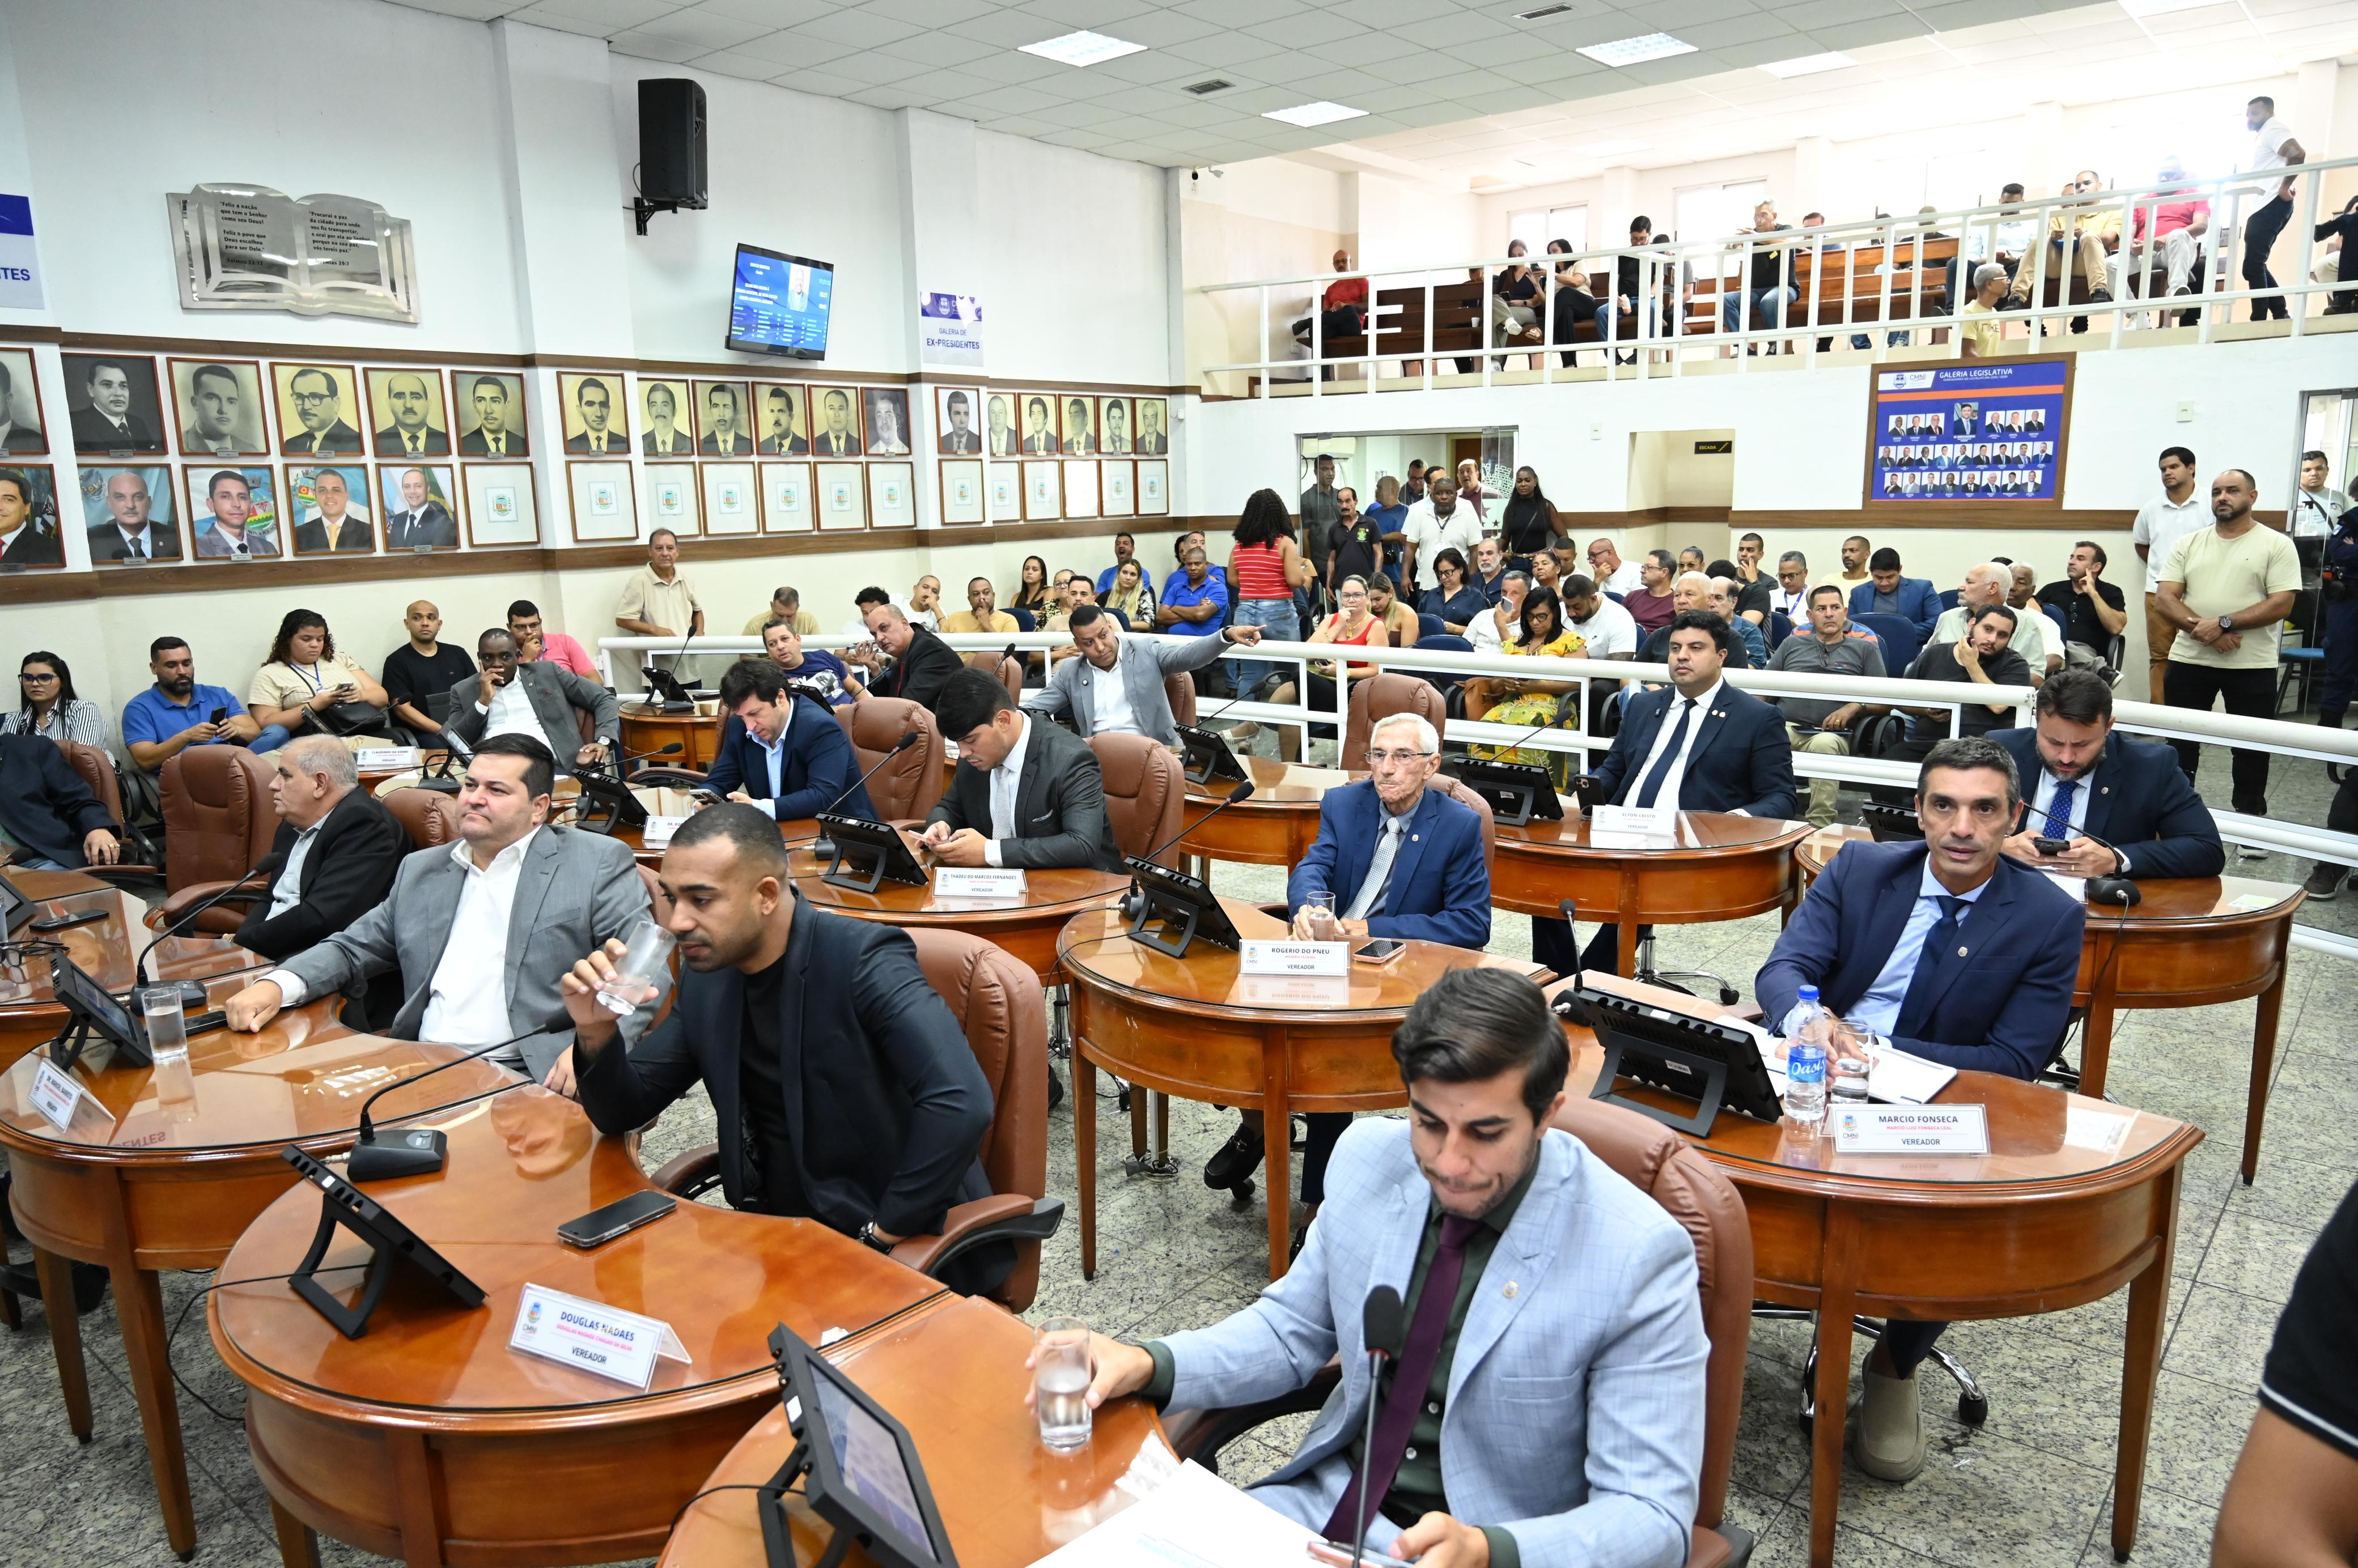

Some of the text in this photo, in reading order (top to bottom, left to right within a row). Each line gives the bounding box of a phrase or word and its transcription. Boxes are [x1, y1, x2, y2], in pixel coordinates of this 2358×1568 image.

[0, 267, 31, 281] TES
[926, 338, 980, 349] EX-PRESIDENTES
[1970, 368, 2013, 377] LEGISLATIVA
[557, 1324, 577, 1335] DOUGLAS
[561, 1311, 635, 1341] DOUGLAS NADAES
[572, 1346, 608, 1364] VEREADOR
